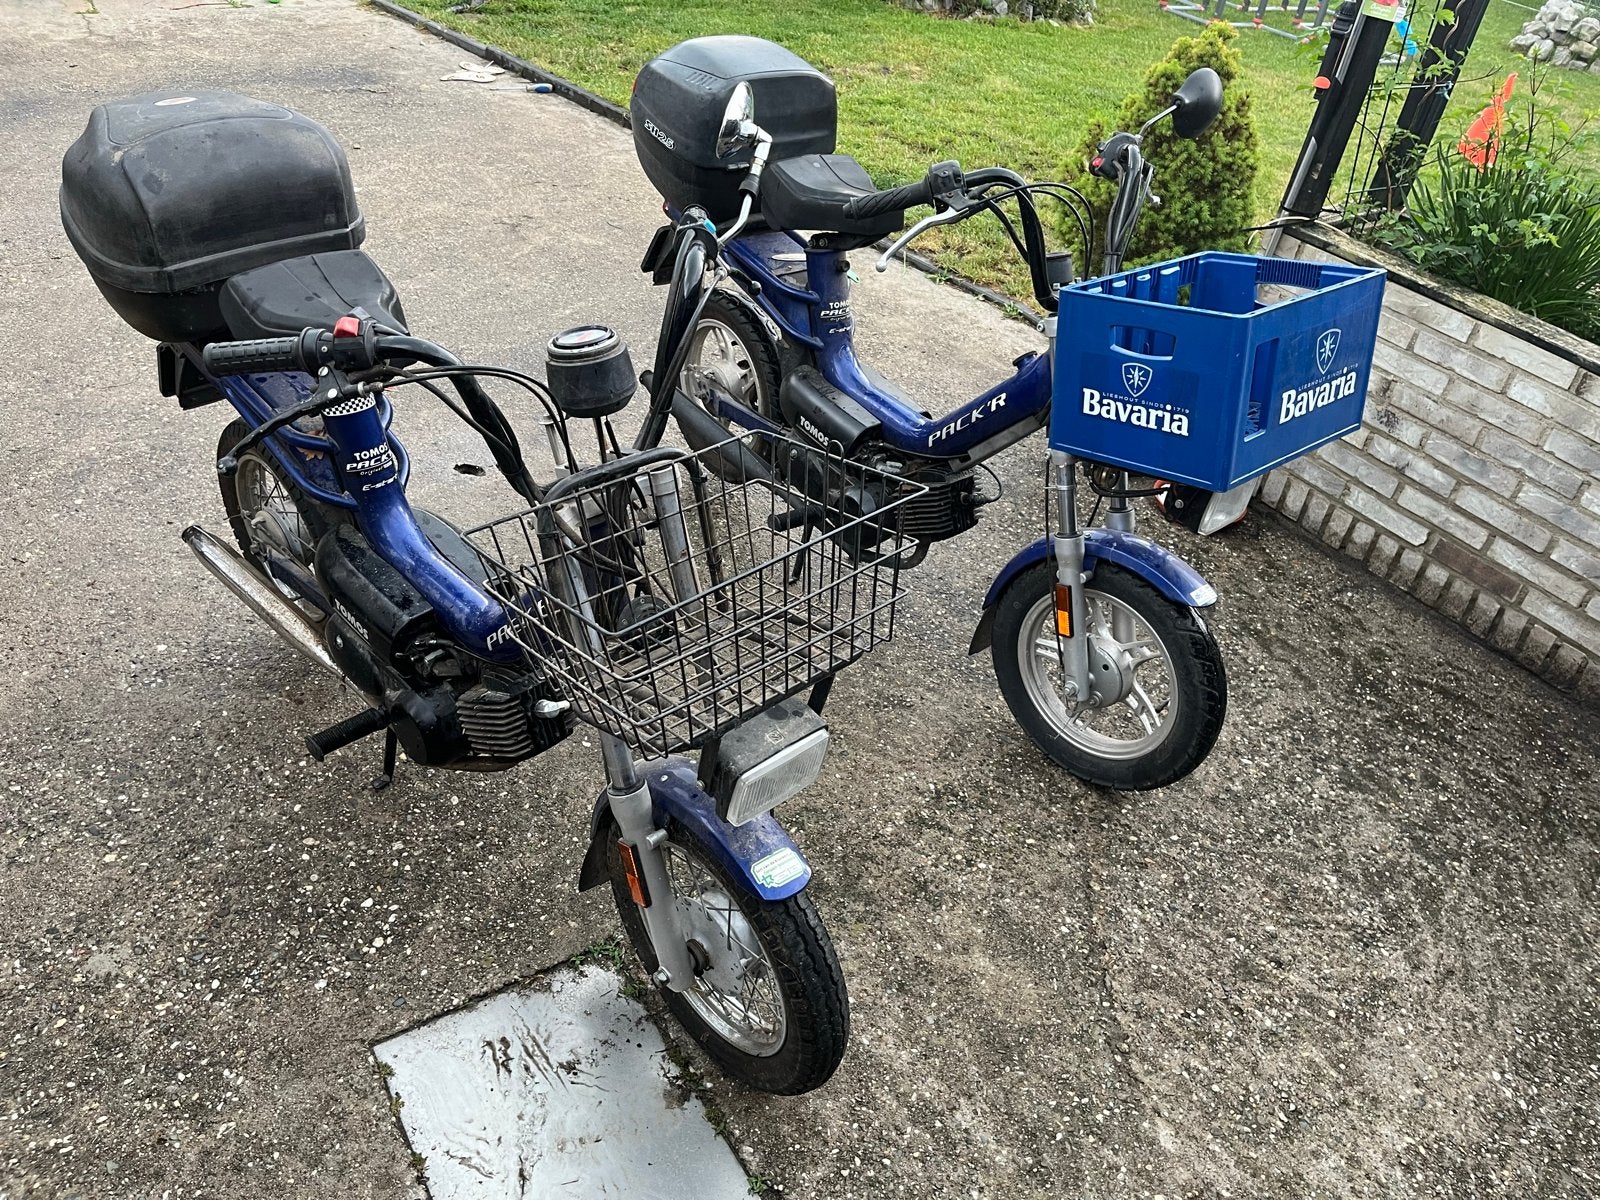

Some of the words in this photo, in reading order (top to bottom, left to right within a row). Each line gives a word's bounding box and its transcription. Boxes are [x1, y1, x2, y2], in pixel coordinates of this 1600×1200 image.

[1083, 388, 1189, 437] Bavaria
[1102, 391, 1139, 403] LIESHOUT
[1173, 406, 1190, 414] 1719
[1279, 366, 1357, 424] Bavaria
[800, 415, 829, 446] TOMOS
[928, 392, 1007, 447] PACK'R
[353, 442, 388, 461] TOMOS
[334, 598, 369, 640] TOMOS
